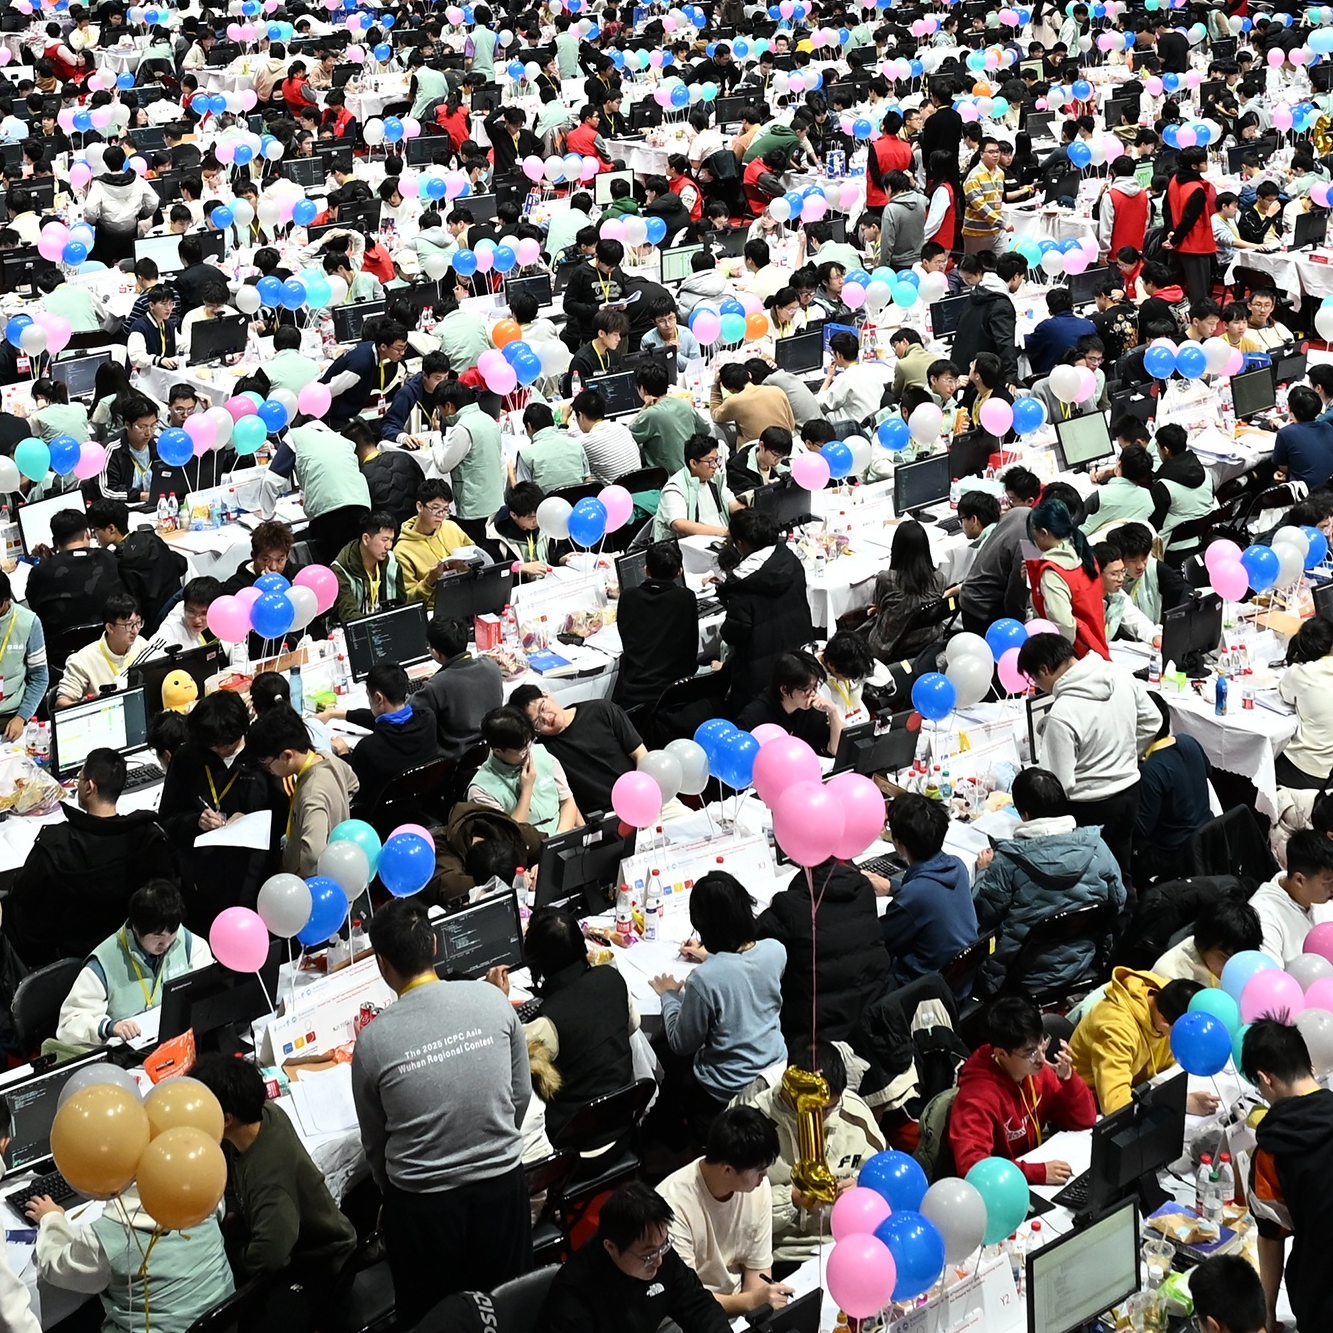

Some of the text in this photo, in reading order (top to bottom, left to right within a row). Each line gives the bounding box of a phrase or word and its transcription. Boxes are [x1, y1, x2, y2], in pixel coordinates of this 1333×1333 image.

[397, 1036, 494, 1075] Wuhan Regional Contest
[404, 1027, 482, 1060] The 2025 ICPC Asia
[999, 1293, 1011, 1306] Y2
